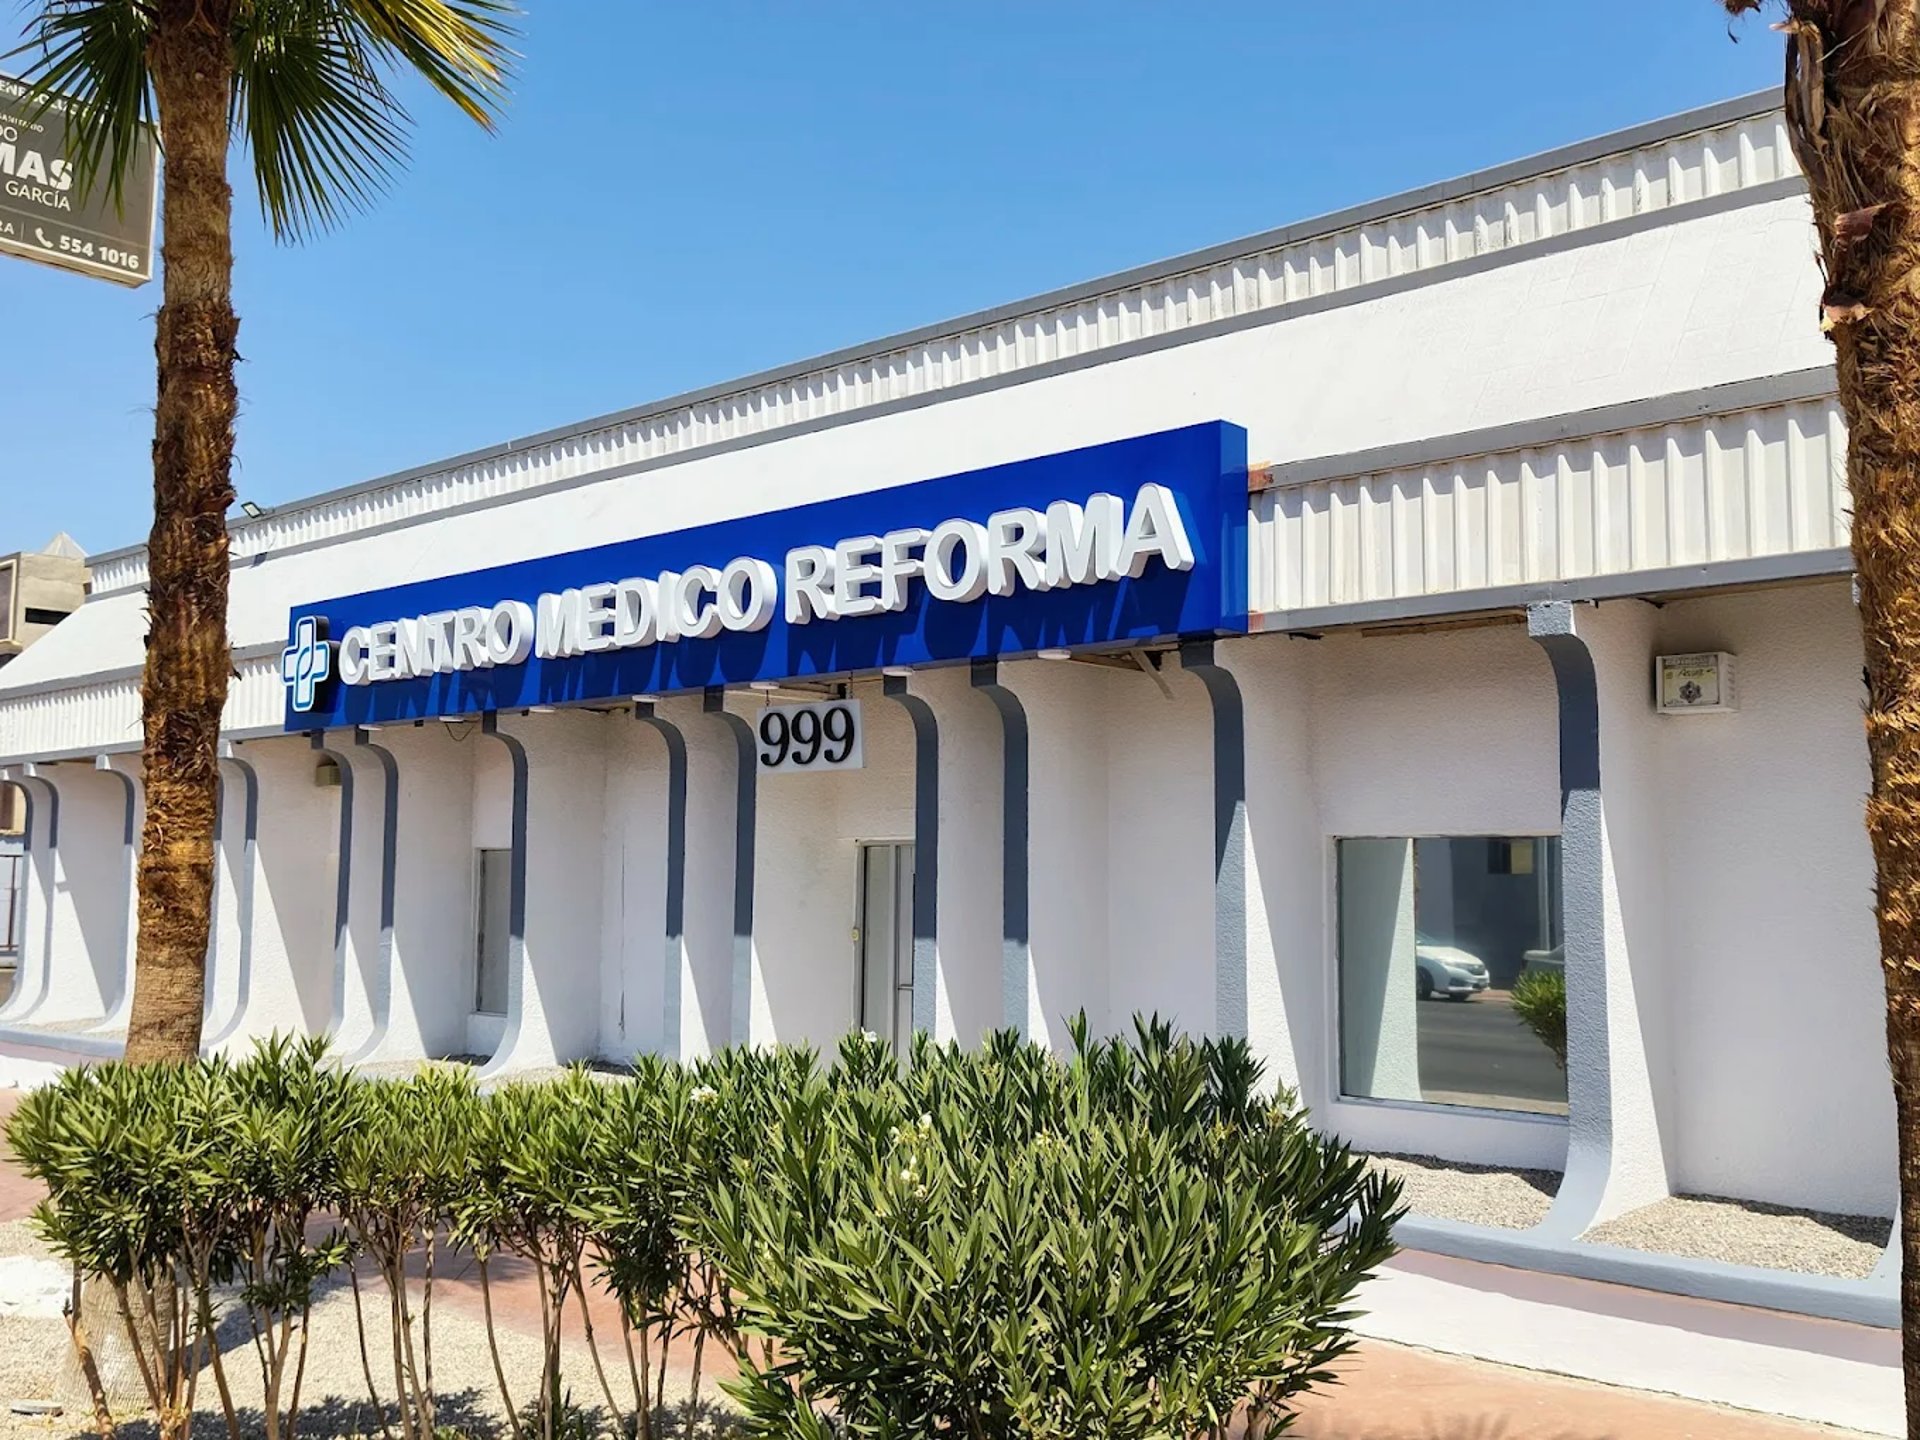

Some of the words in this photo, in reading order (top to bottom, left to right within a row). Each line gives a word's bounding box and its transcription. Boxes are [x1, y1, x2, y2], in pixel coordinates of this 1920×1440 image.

[0, 124, 18, 142] O
[5, 180, 71, 212] GARCÍA
[59, 235, 94, 257] 554
[99, 246, 139, 269] 1016
[338, 599, 535, 686] CENTRO
[535, 556, 777, 658] MEDICO
[785, 482, 1194, 625] REFORMA
[759, 706, 856, 768] 999
